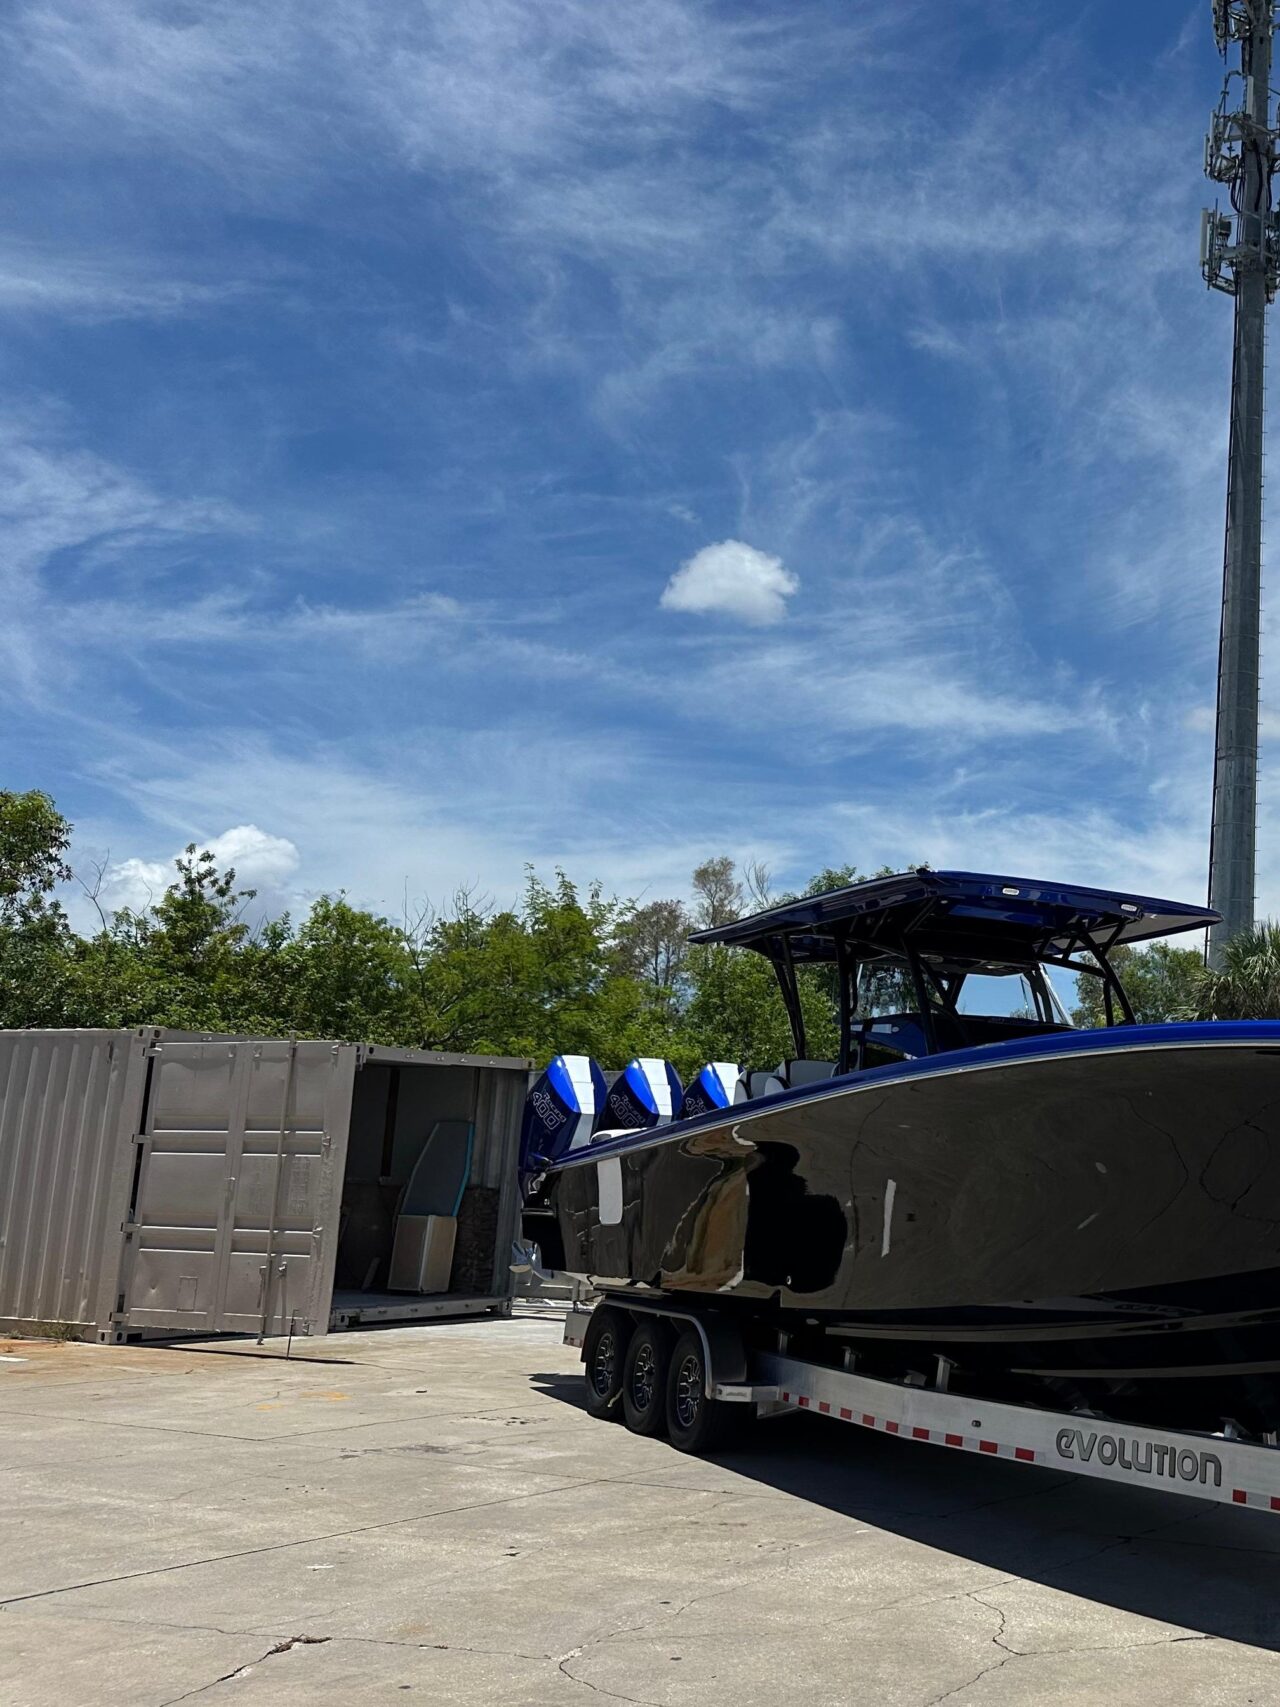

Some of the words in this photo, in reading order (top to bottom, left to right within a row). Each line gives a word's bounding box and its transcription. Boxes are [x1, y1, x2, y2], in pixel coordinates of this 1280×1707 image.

[532, 1091, 561, 1130] 400
[543, 1091, 567, 1123] Racing
[610, 1094, 640, 1128] 400
